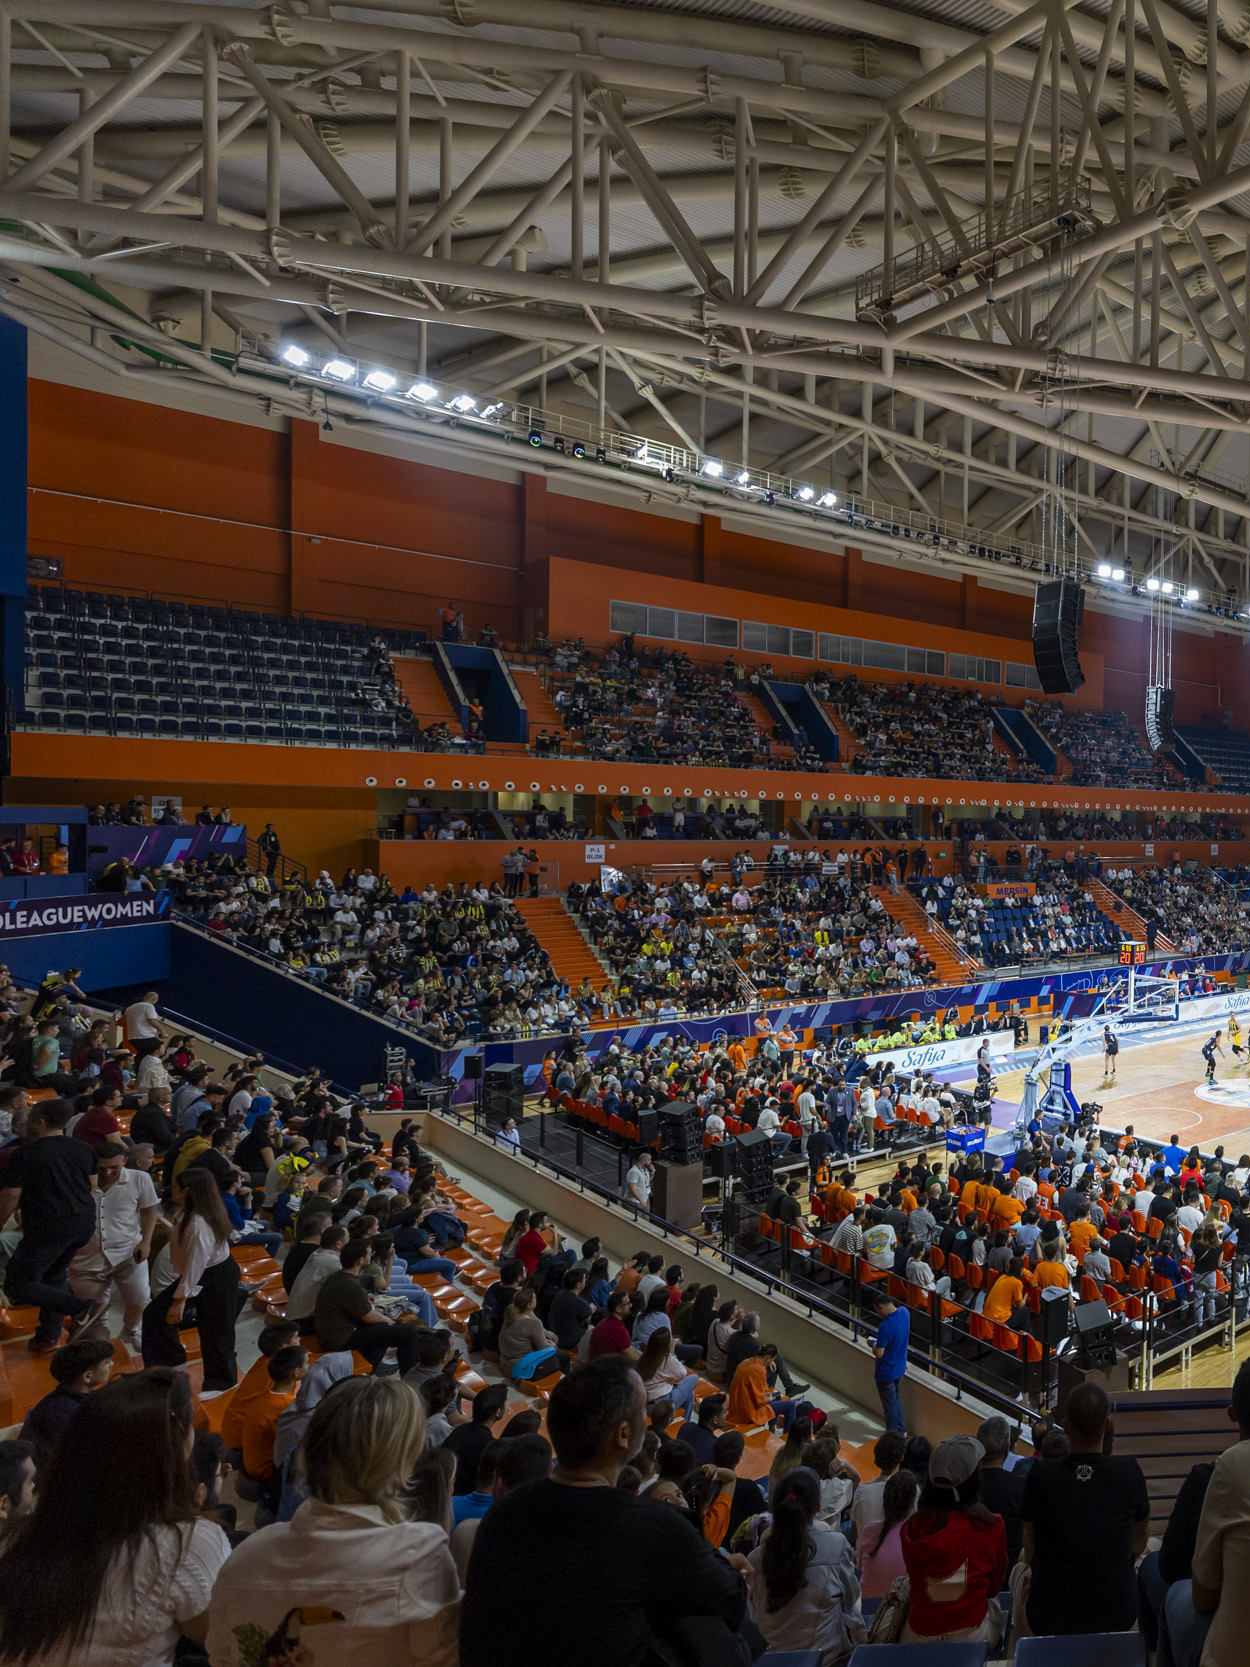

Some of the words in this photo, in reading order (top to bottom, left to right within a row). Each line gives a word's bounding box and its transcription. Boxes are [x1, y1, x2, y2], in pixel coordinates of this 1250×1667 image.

[996, 884, 1029, 895] MERSİN
[0, 899, 155, 930] LEAGUEWOMEN
[1120, 952, 1131, 964] 20
[1134, 952, 1145, 964] 20
[1224, 994, 1250, 1010] Safiya
[902, 1047, 946, 1069] Safiya
